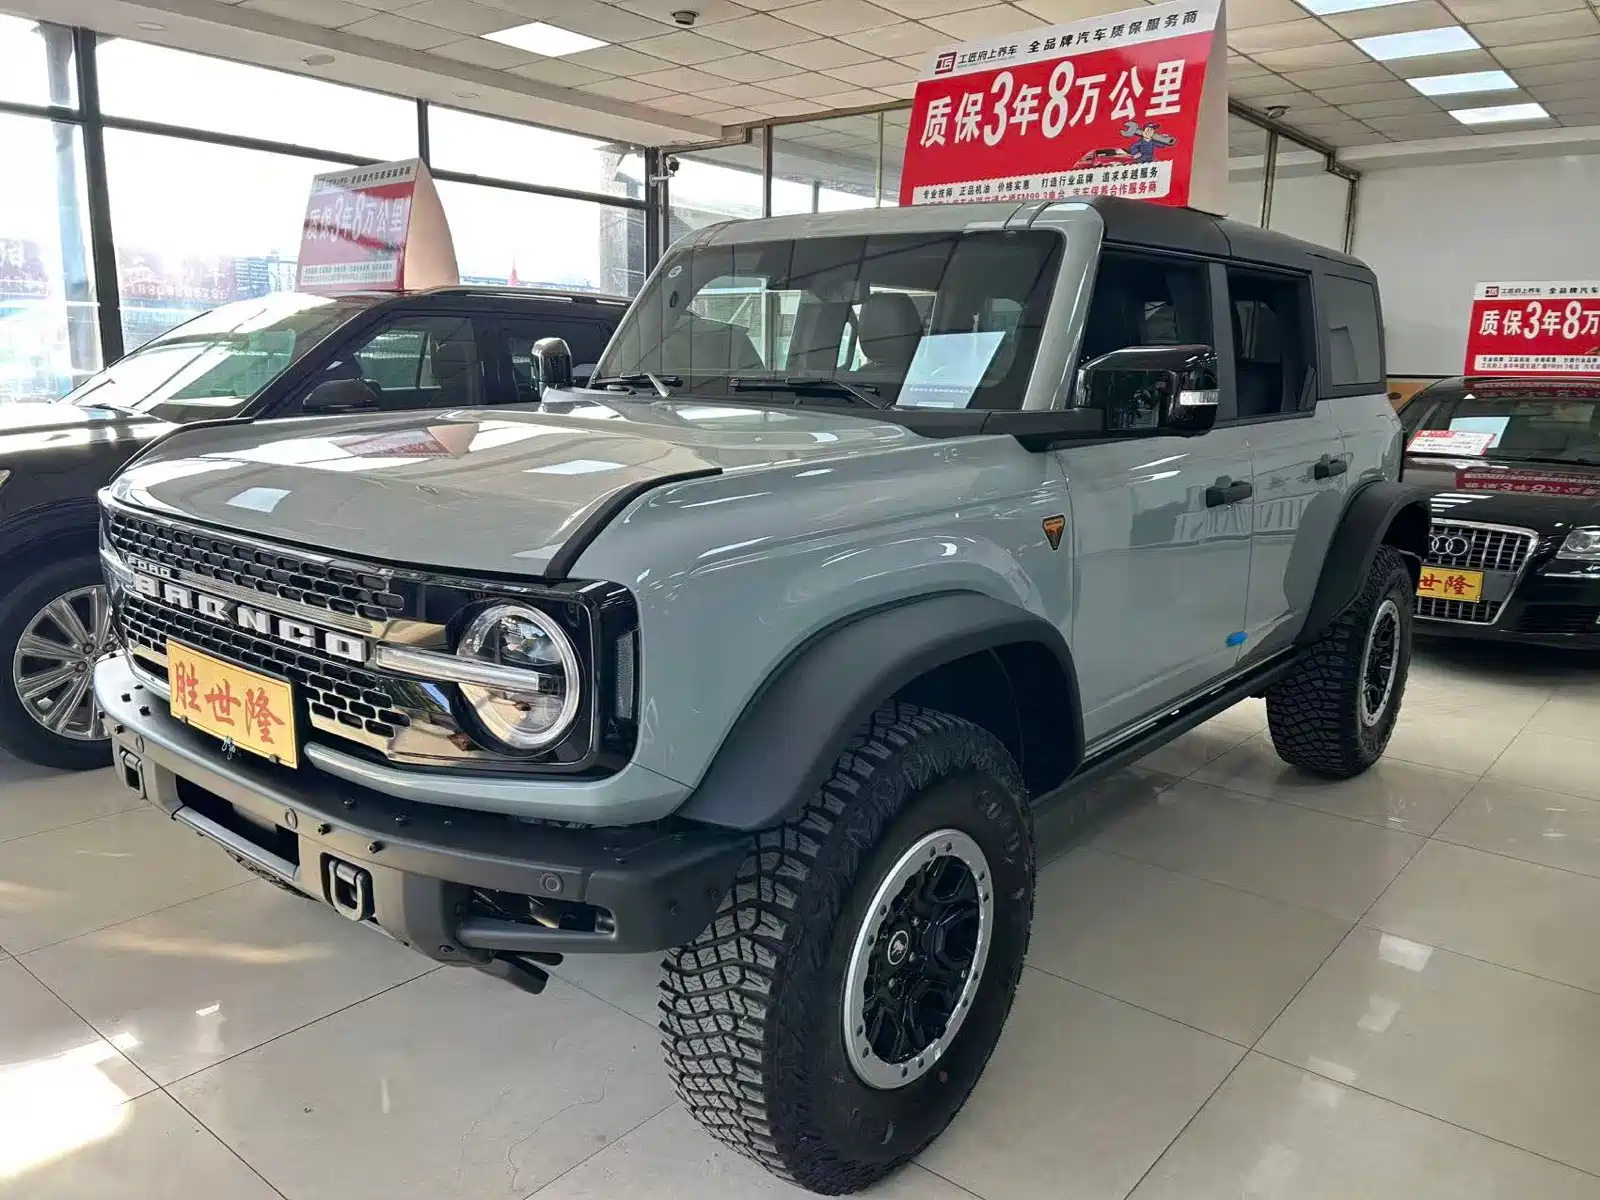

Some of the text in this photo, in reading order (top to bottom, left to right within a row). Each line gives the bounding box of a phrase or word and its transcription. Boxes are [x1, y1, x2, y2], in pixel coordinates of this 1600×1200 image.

[1027, 9, 1199, 54] 全品牌汽车质保服务商
[919, 58, 1187, 149] 质保3年8万公里
[959, 183, 991, 196] 正品机油
[1041, 172, 1094, 189] 打造行业品牌
[1101, 165, 1159, 183] 追求卓越服务
[1479, 300, 1600, 339] 质保3年8万
[127, 555, 172, 578] FORD
[173, 660, 286, 745] 胜世隆
